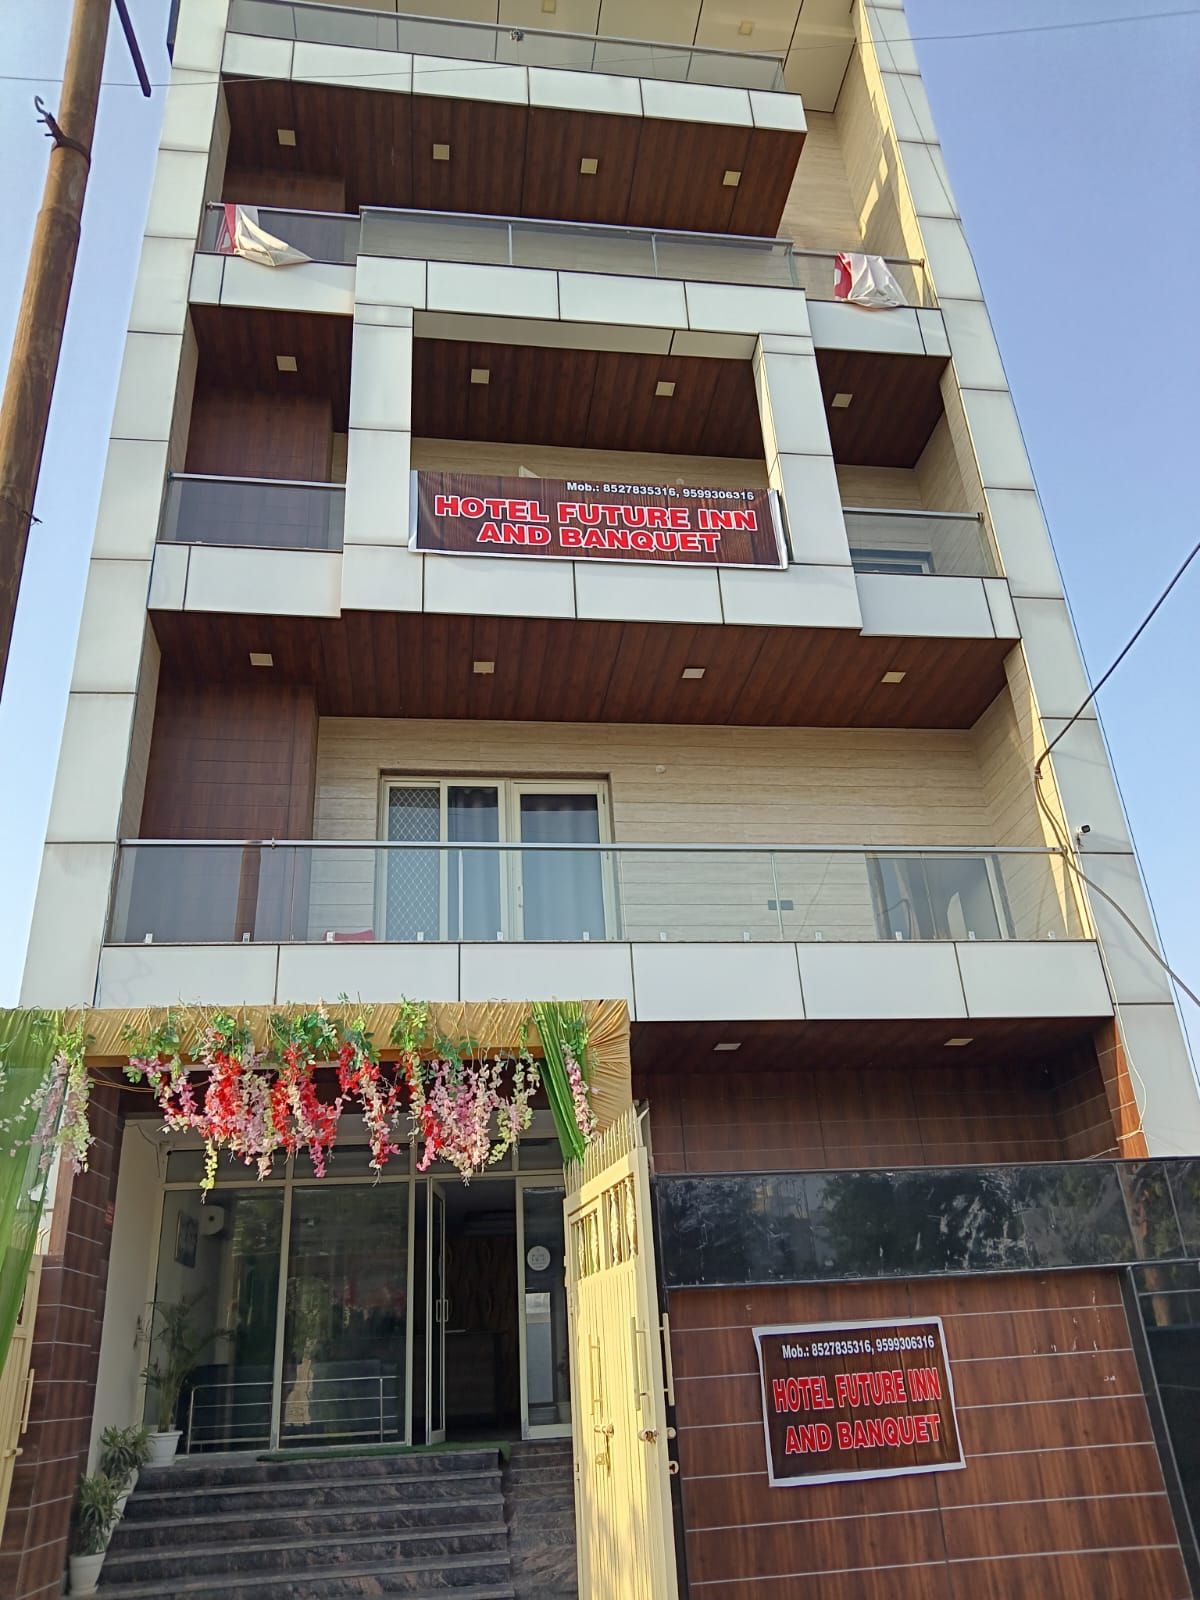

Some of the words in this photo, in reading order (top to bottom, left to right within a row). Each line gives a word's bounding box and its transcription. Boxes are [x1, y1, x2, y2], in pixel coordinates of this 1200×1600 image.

[567, 481, 600, 492] Mob.:
[603, 483, 680, 498] 8527835316,
[683, 487, 755, 501] 9599306316
[435, 495, 549, 521] HOTEL
[557, 502, 690, 530] FUTURE
[698, 508, 758, 532] INN
[477, 522, 551, 545] AND
[559, 527, 722, 553] BANQUET
[783, 1344, 810, 1358] Mob.:
[811, 1339, 875, 1357] 8527835316,
[876, 1335, 935, 1353] 9599306316
[772, 1376, 834, 1412] HOTEL
[835, 1369, 907, 1408] FUTURE
[907, 1367, 942, 1402] INN
[785, 1423, 833, 1455] AND
[836, 1413, 941, 1451] BANQUET
